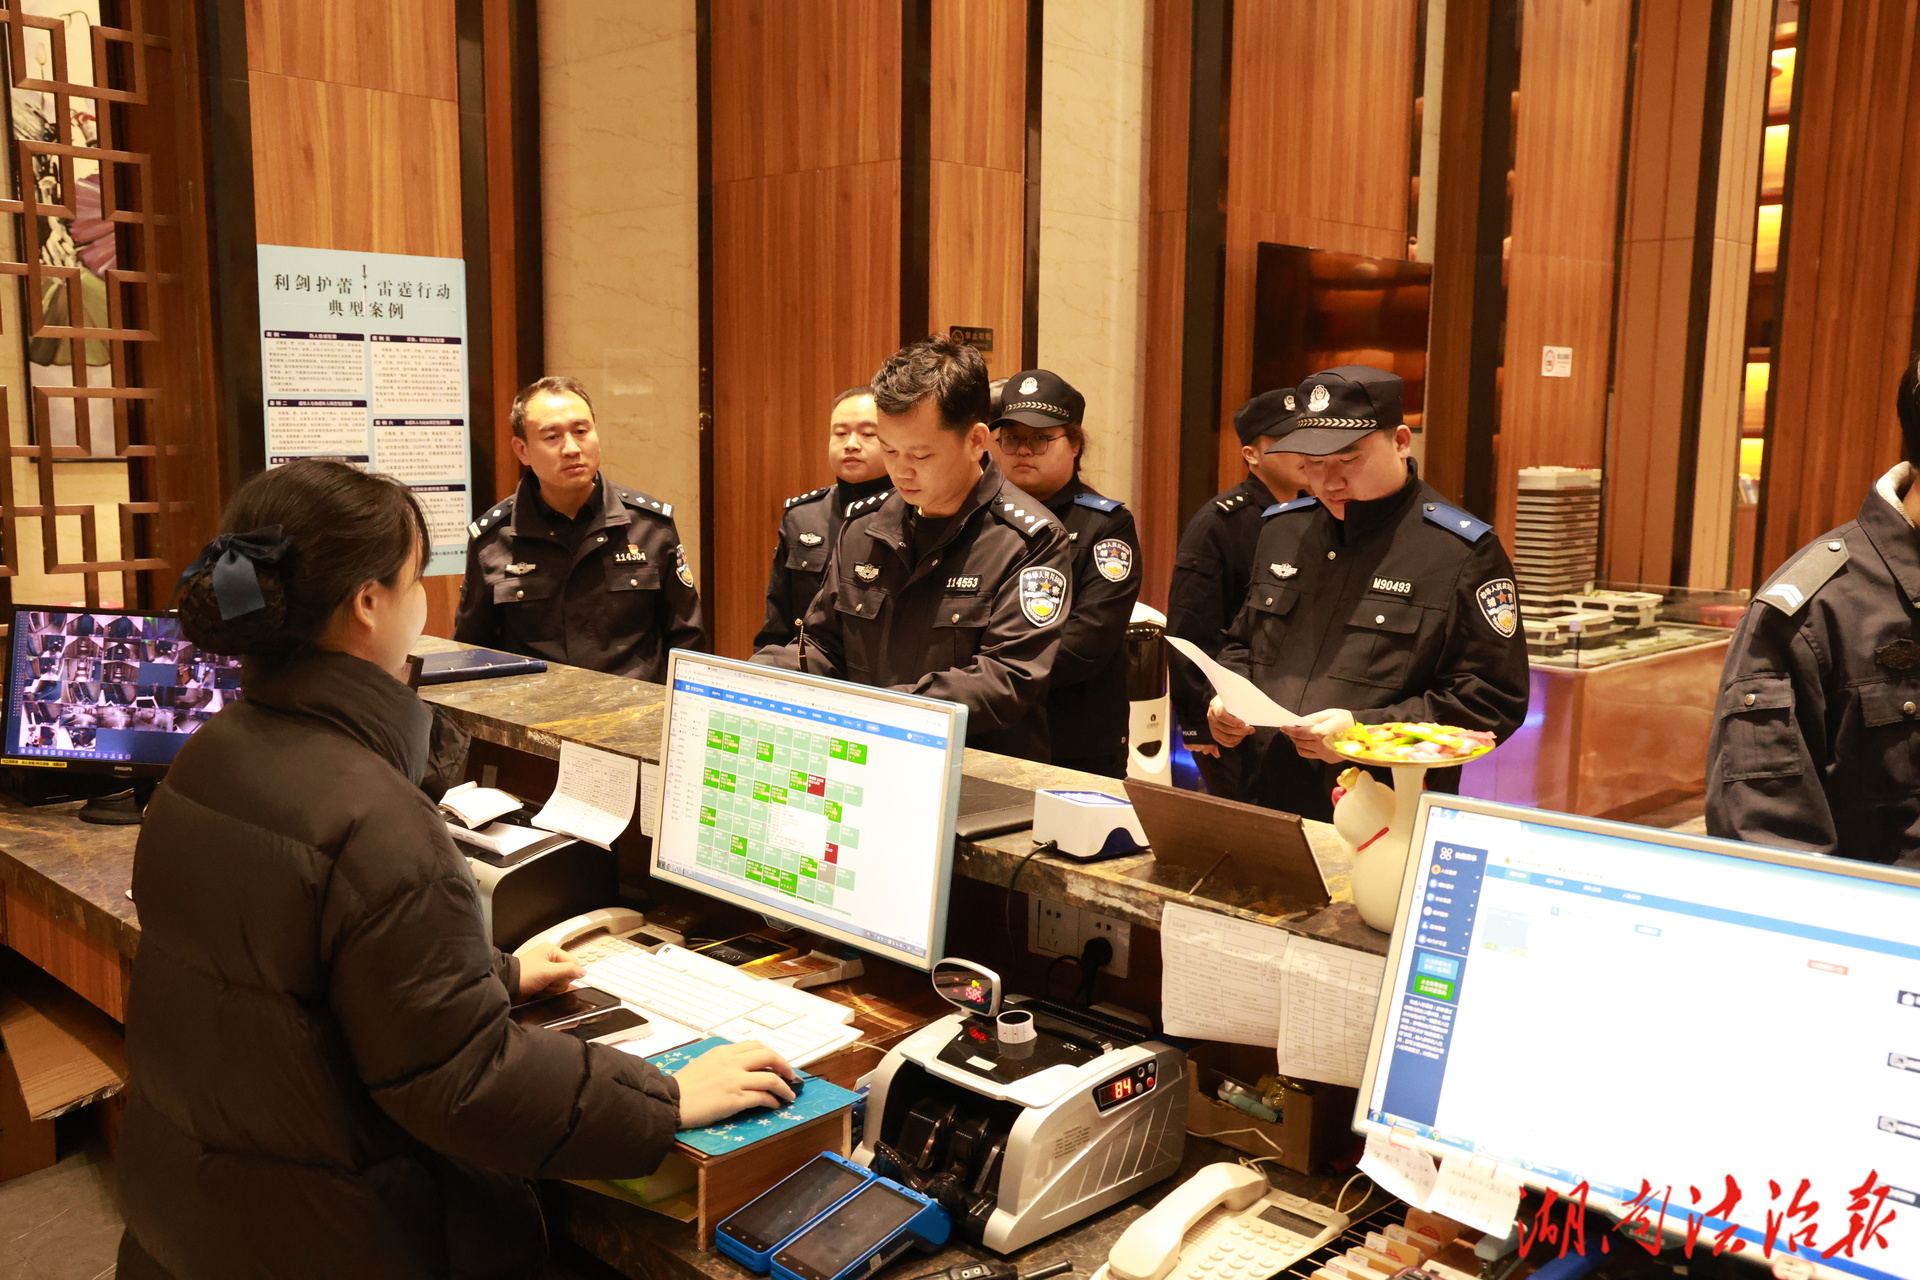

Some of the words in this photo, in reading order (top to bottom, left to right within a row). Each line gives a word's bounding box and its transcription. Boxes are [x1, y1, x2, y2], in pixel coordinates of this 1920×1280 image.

[328, 299, 404, 320] 典型案例
[946, 576, 979, 588] 114553
[1372, 577, 1412, 594] M90493
[1115, 1078, 1132, 1100] 84
